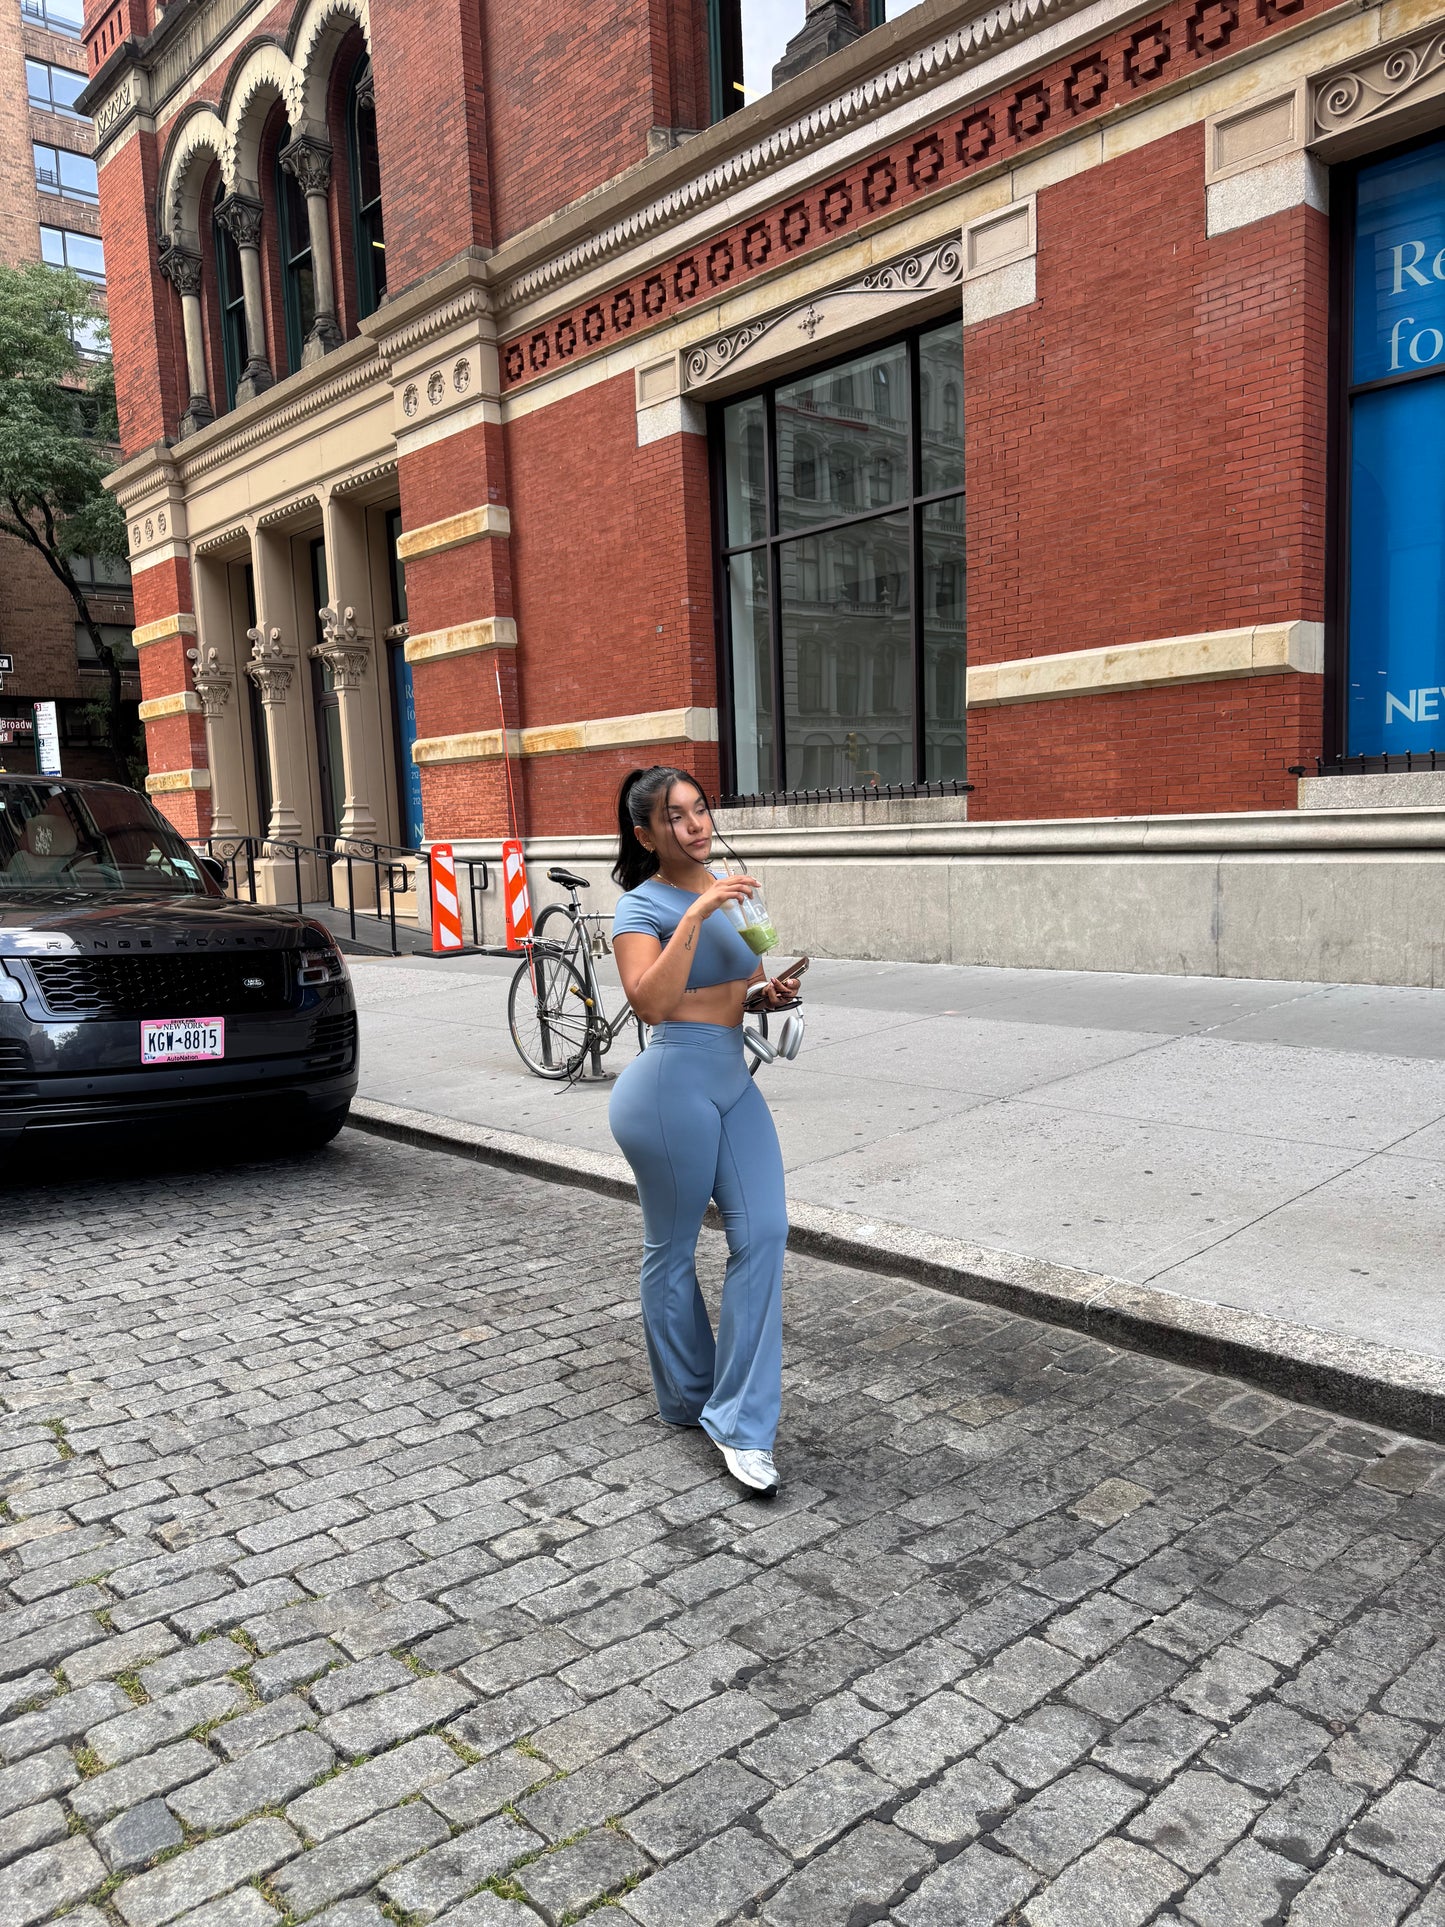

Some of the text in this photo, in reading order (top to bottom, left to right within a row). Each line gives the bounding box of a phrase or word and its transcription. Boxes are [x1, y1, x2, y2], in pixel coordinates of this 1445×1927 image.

[1387, 317, 1444, 372] fo
[46, 936, 268, 950] RANGE ROVER
[149, 1029, 217, 1053] KGW 8815
